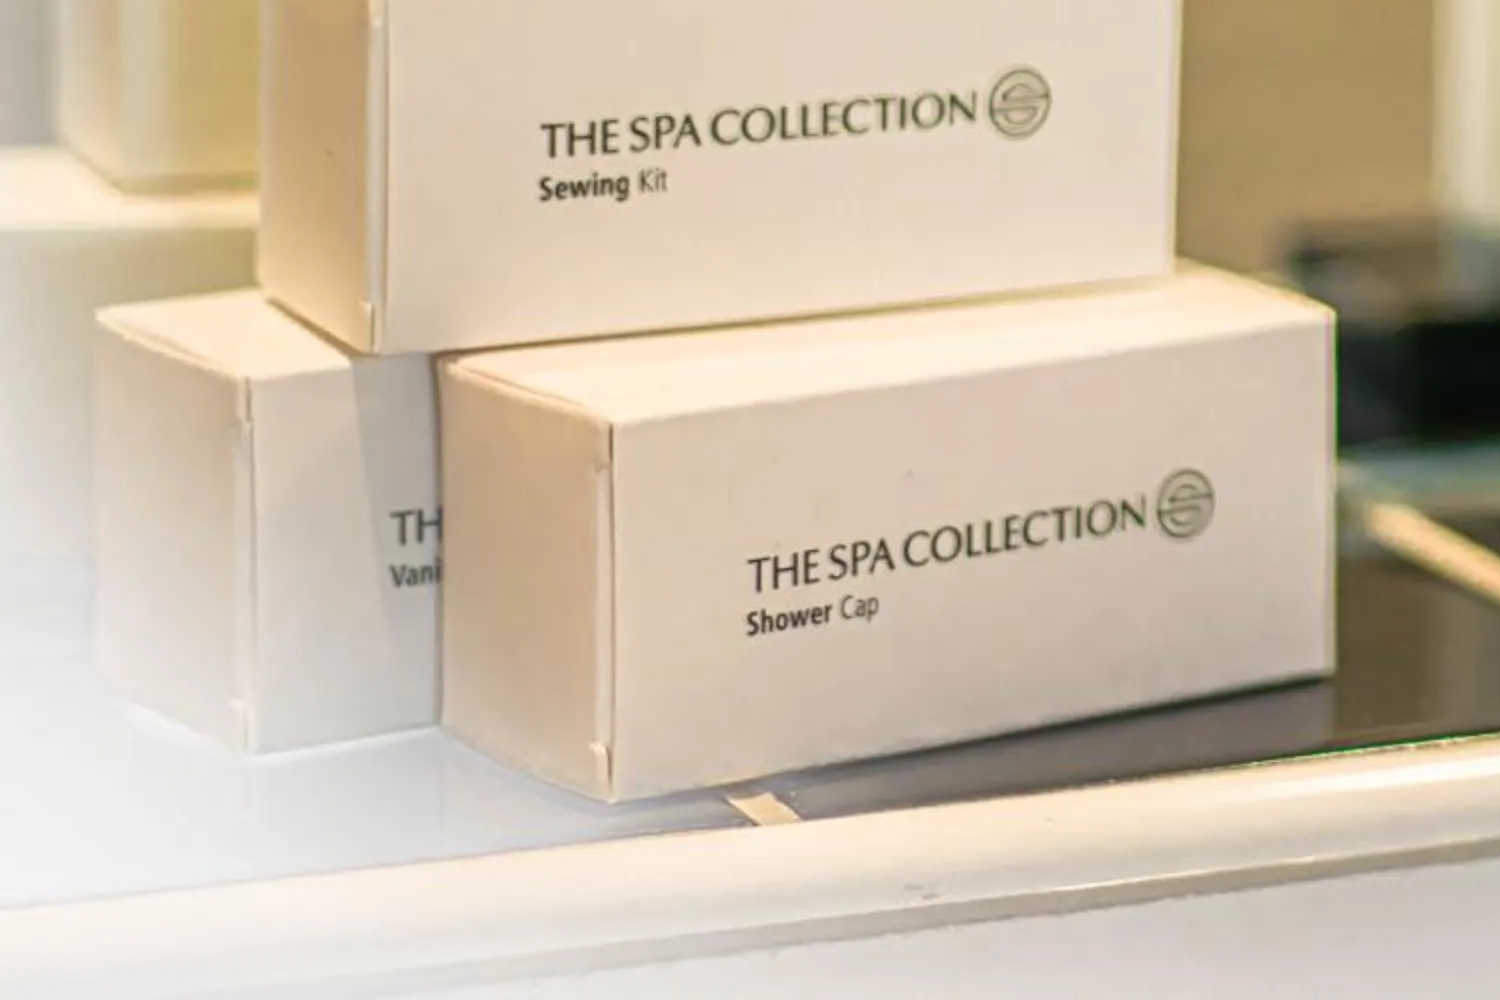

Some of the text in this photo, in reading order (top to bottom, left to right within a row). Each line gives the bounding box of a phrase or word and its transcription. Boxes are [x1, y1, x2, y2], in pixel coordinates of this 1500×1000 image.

[540, 90, 977, 159] THE SPA COLLECTION
[538, 167, 668, 202] Sewing Kit
[388, 505, 443, 546] TH
[747, 493, 1147, 594] THE SPA COLLECTION
[387, 557, 442, 588] Vani
[746, 593, 880, 637] Shower Cap
